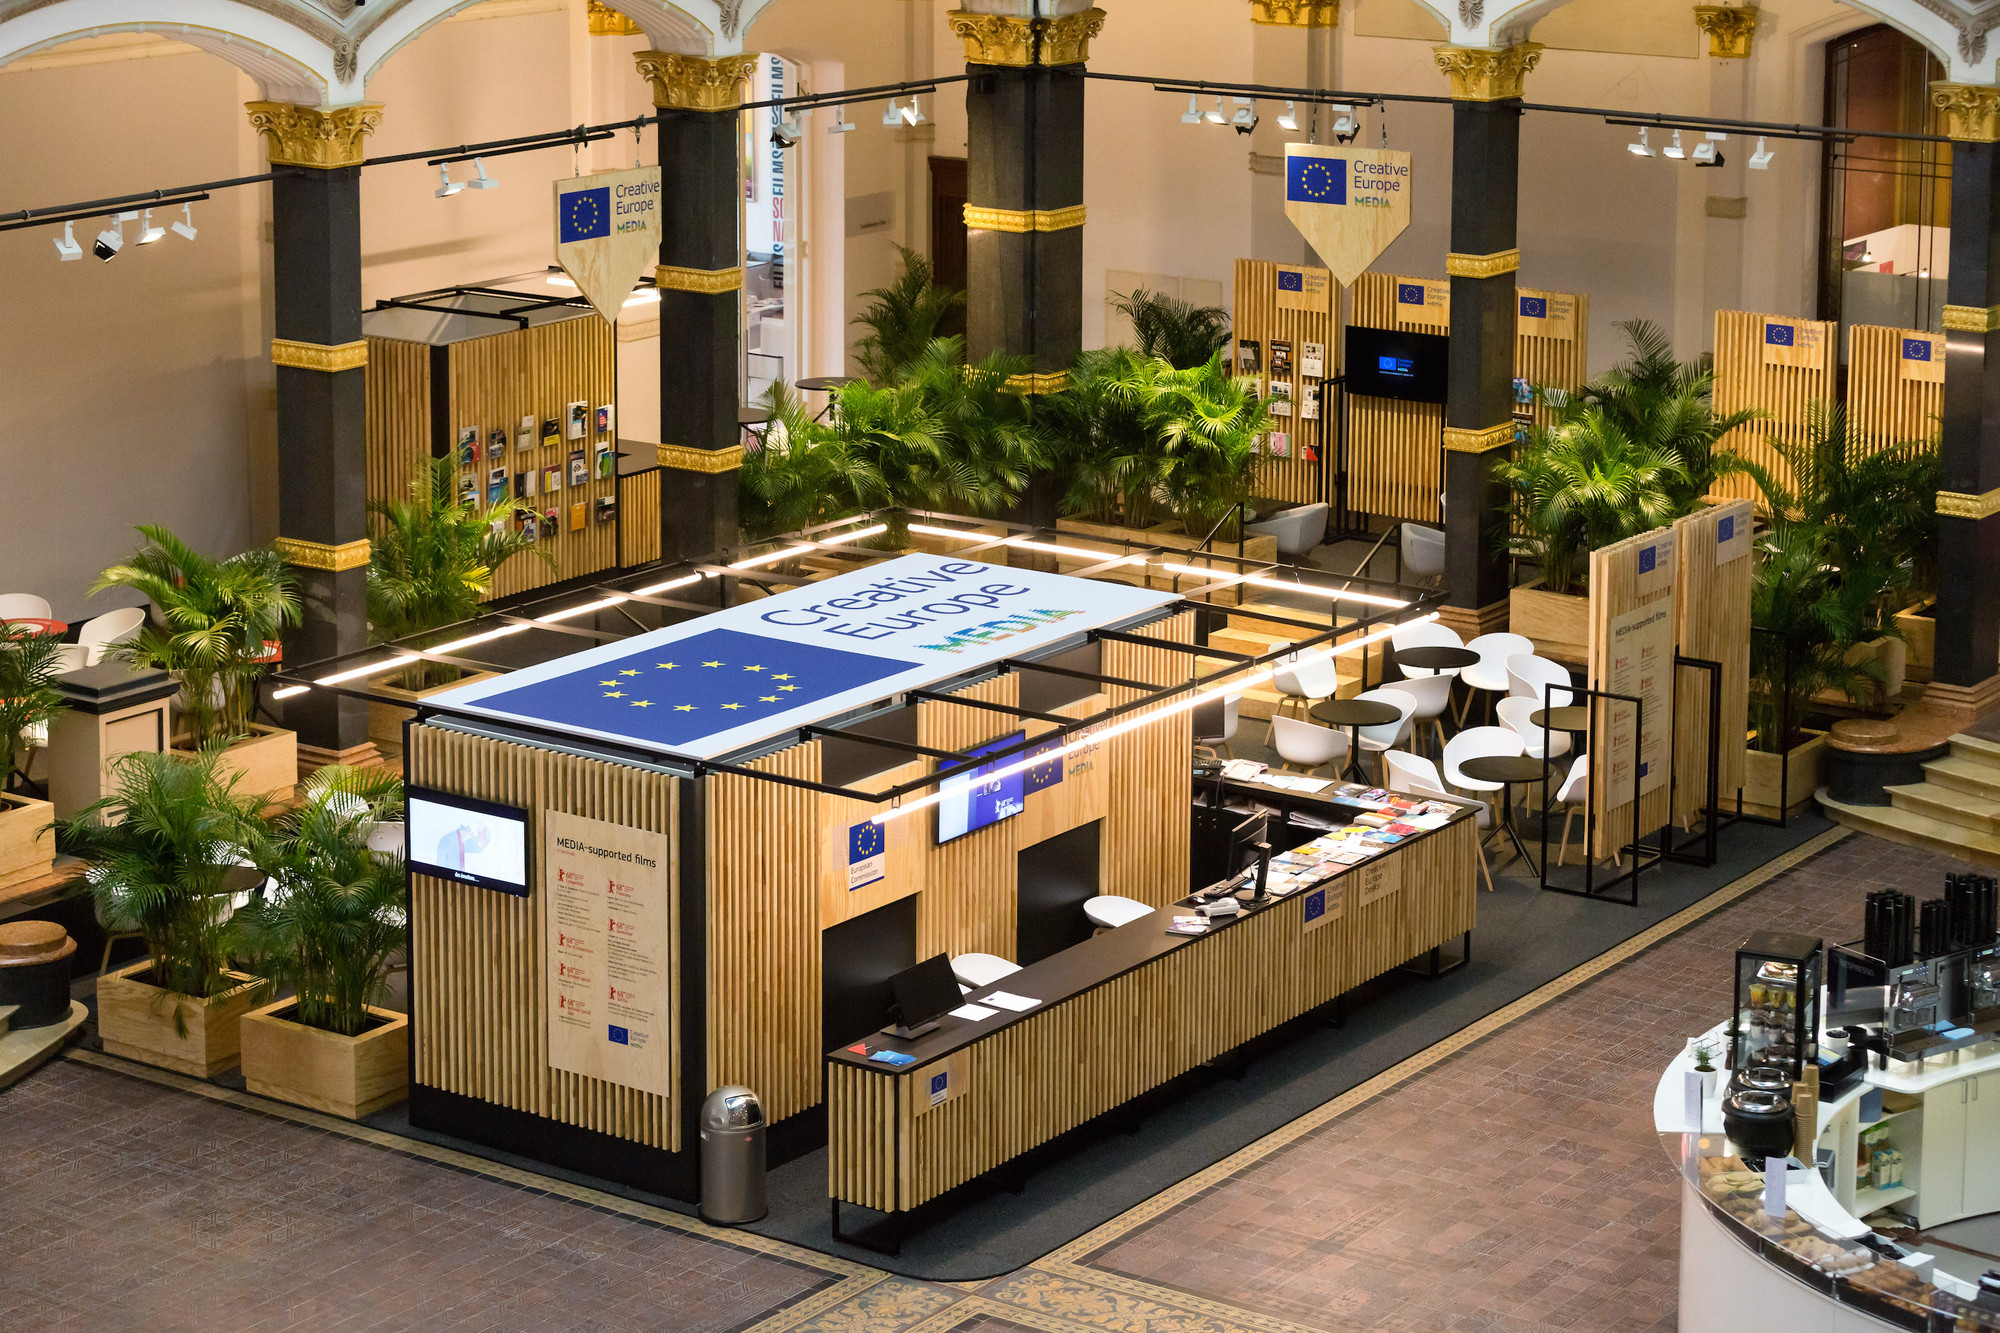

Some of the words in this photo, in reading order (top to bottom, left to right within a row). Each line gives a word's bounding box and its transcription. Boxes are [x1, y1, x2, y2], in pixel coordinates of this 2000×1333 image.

[1354, 160, 1408, 176] Creative
[616, 180, 660, 198] Creative
[1354, 176, 1400, 193] Europe
[616, 199, 654, 215] Europe
[1354, 196, 1391, 209] MEDIA
[617, 220, 647, 235] MEDIA
[1305, 273, 1327, 281] Creative
[1427, 286, 1450, 294] Creative
[1549, 299, 1573, 307] Creative
[1797, 326, 1823, 335] Creative
[1797, 333, 1819, 342] Europe
[760, 562, 990, 626] Creative
[823, 583, 1031, 641] Europe
[913, 608, 1086, 654] MEDIA
[1615, 614, 1655, 638] MEDIA-supported
[1655, 610, 1667, 621] films
[1068, 761, 1094, 779] MEDIA
[556, 836, 632, 862] MEDIA-supported
[635, 853, 657, 868] films
[850, 861, 873, 875] European
[1365, 862, 1387, 876] Creative
[850, 869, 879, 884] Commission
[1365, 873, 1383, 886] Europe
[1327, 880, 1346, 894] Creative
[1365, 883, 1380, 895] Desks
[1327, 890, 1344, 903] Europe
[630, 1029, 649, 1039] Creative
[630, 1035, 647, 1044] Europe
